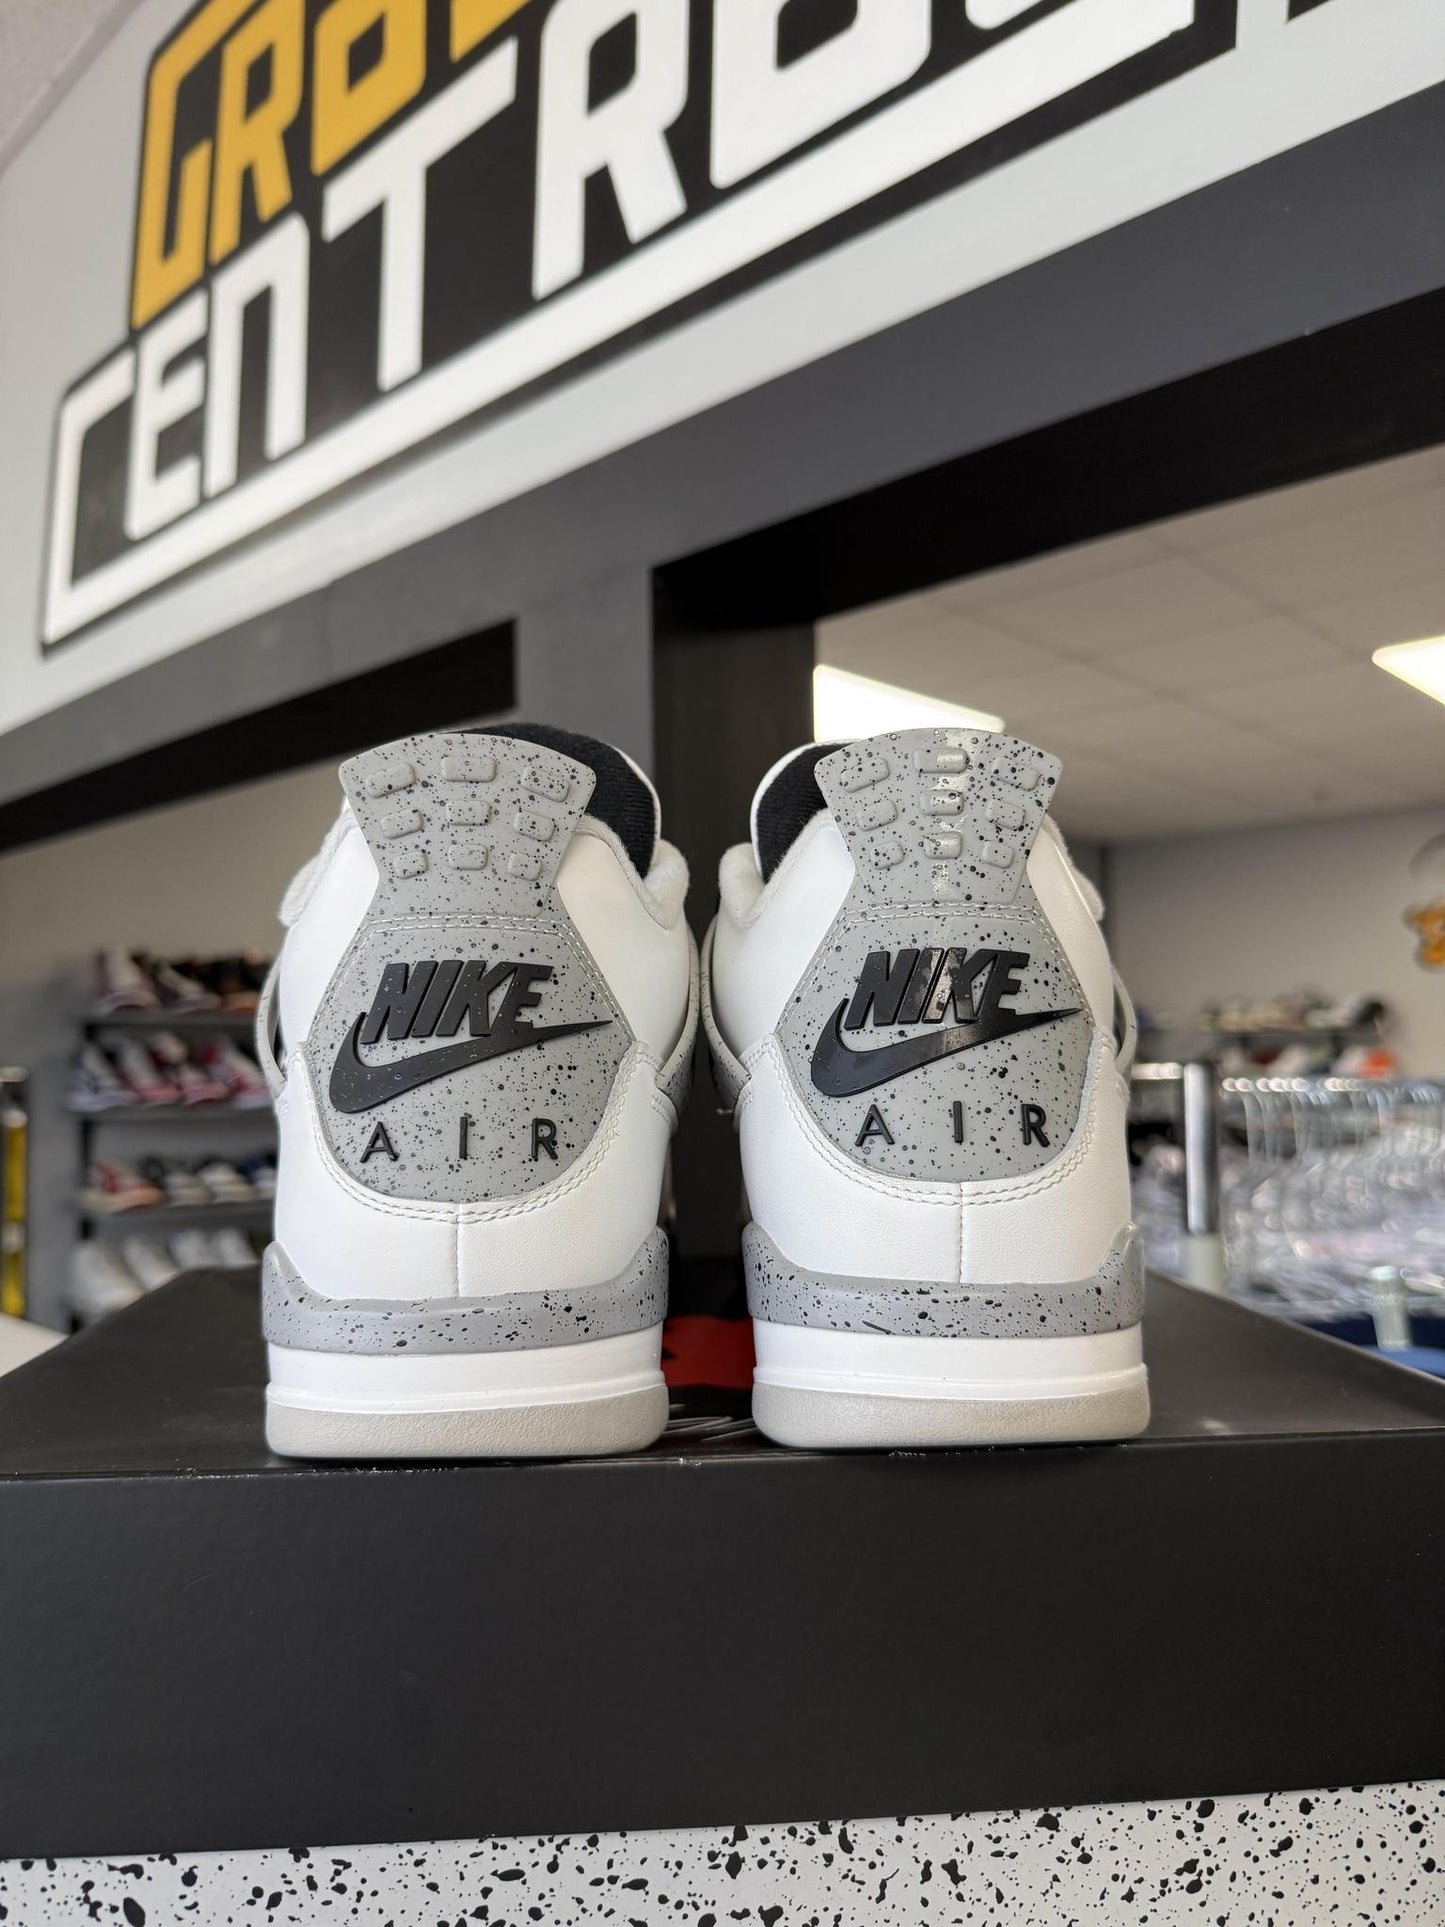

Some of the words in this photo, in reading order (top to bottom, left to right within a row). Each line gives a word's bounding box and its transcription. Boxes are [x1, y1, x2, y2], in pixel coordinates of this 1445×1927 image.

[360, 958, 554, 1045] NIKE
[844, 947, 1031, 1031] NIKE
[359, 1115, 559, 1164] AIR
[854, 1100, 1050, 1148] AIR
